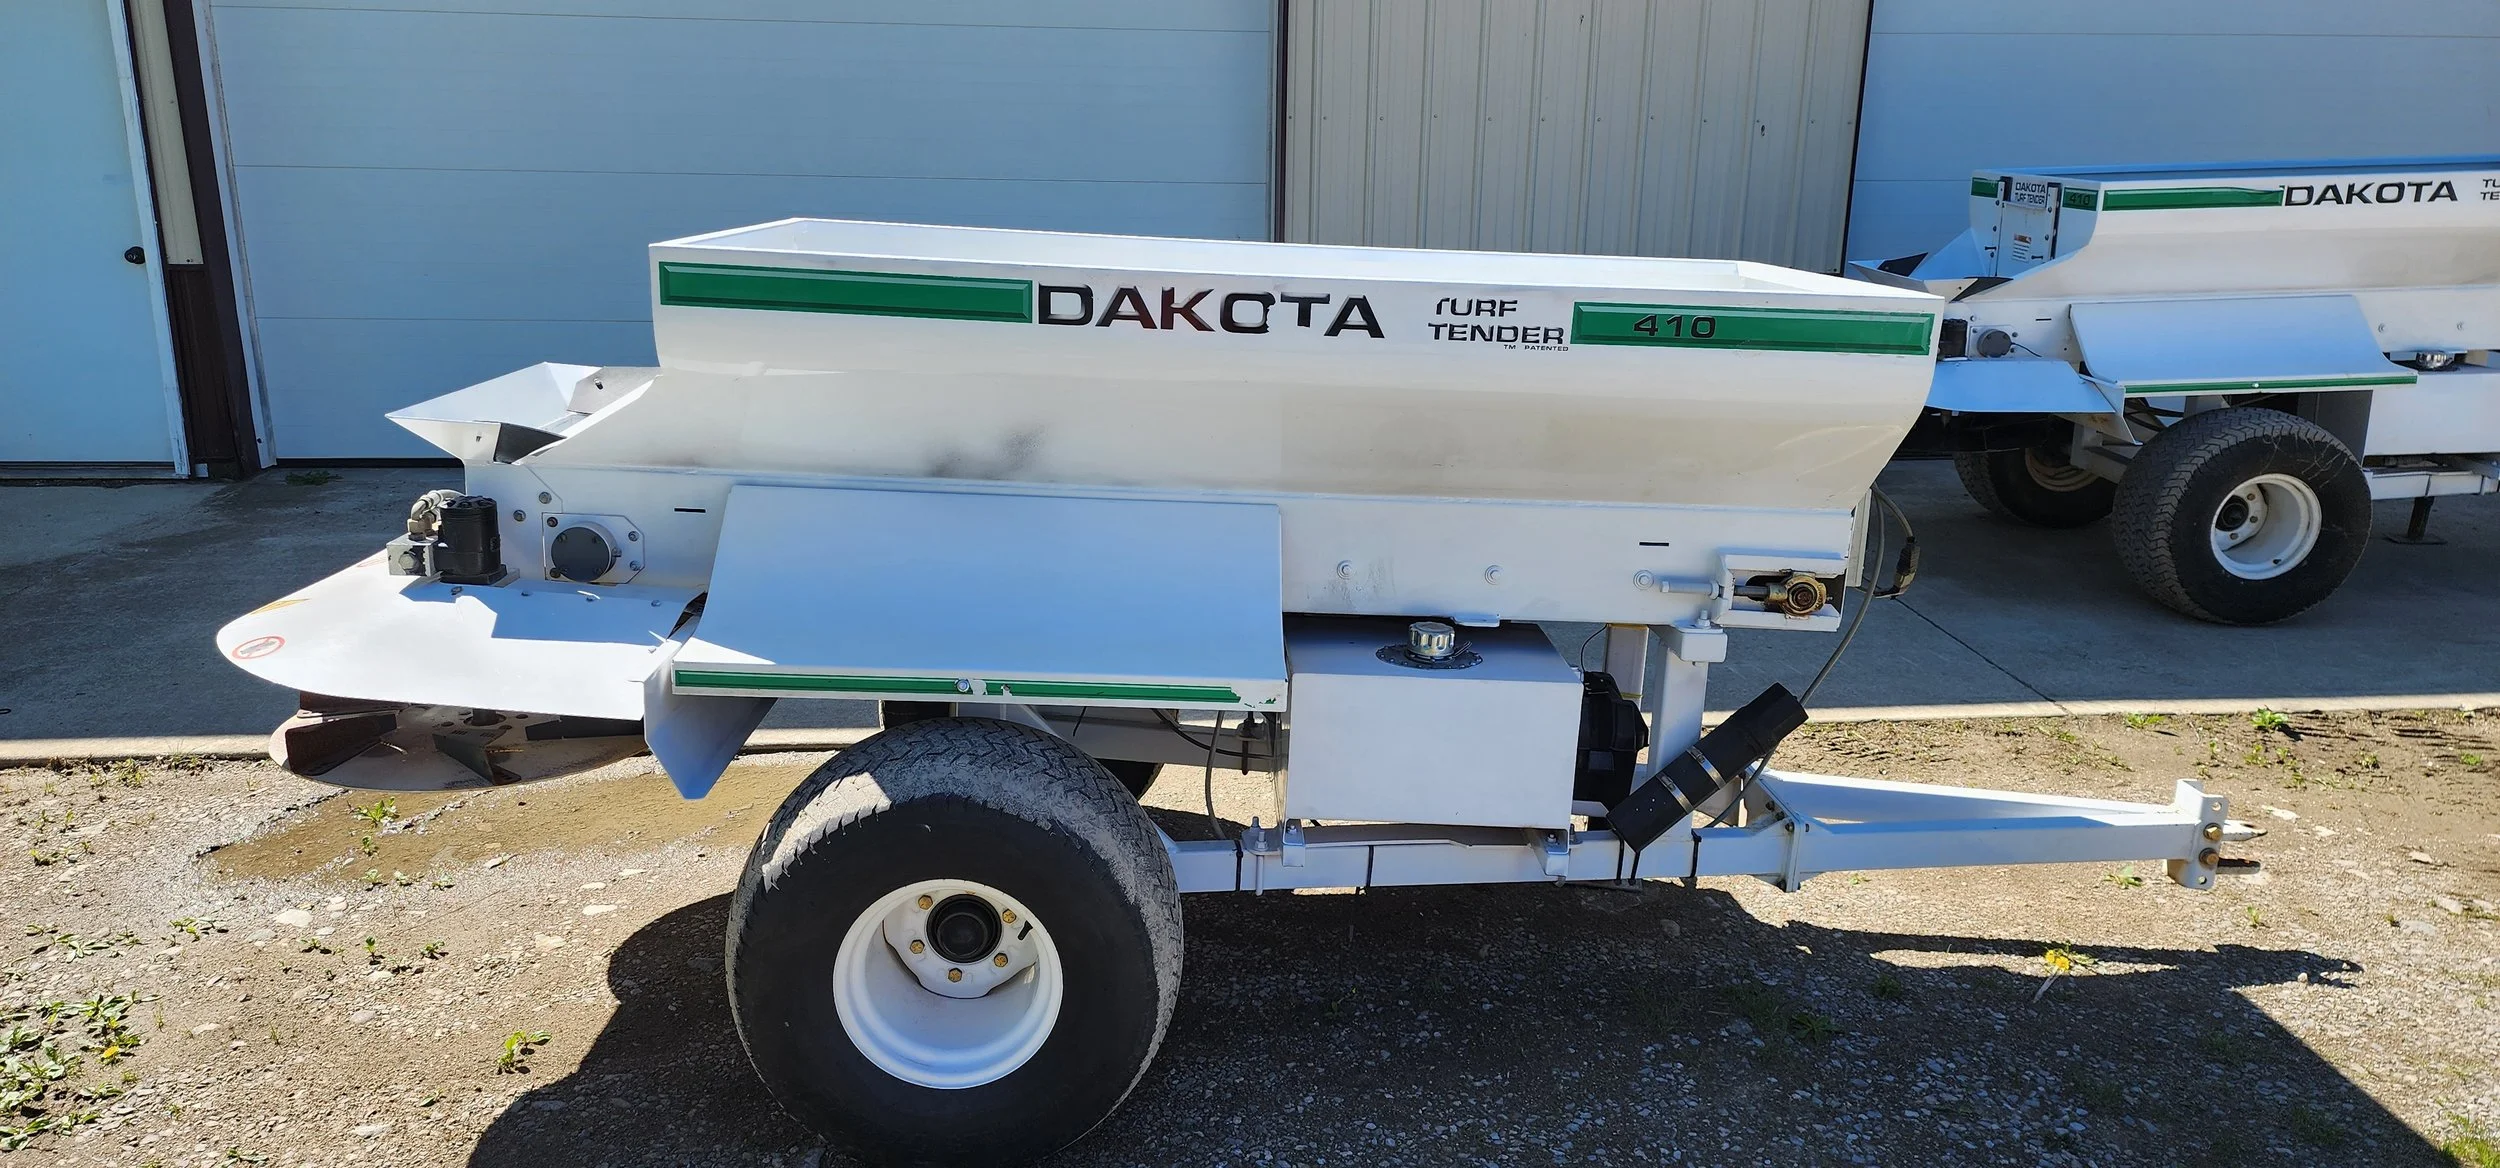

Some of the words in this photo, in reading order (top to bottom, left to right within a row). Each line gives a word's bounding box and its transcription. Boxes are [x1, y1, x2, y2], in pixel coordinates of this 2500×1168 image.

[2015, 182, 2046, 194] DAKOTA
[2070, 193, 2091, 206] 410
[2284, 180, 2458, 206] DAKOTA
[1038, 282, 1385, 339] DAKOTA
[1436, 297, 1518, 317] TURF
[1428, 322, 1564, 345] TENDER
[1633, 314, 1716, 339] 410
